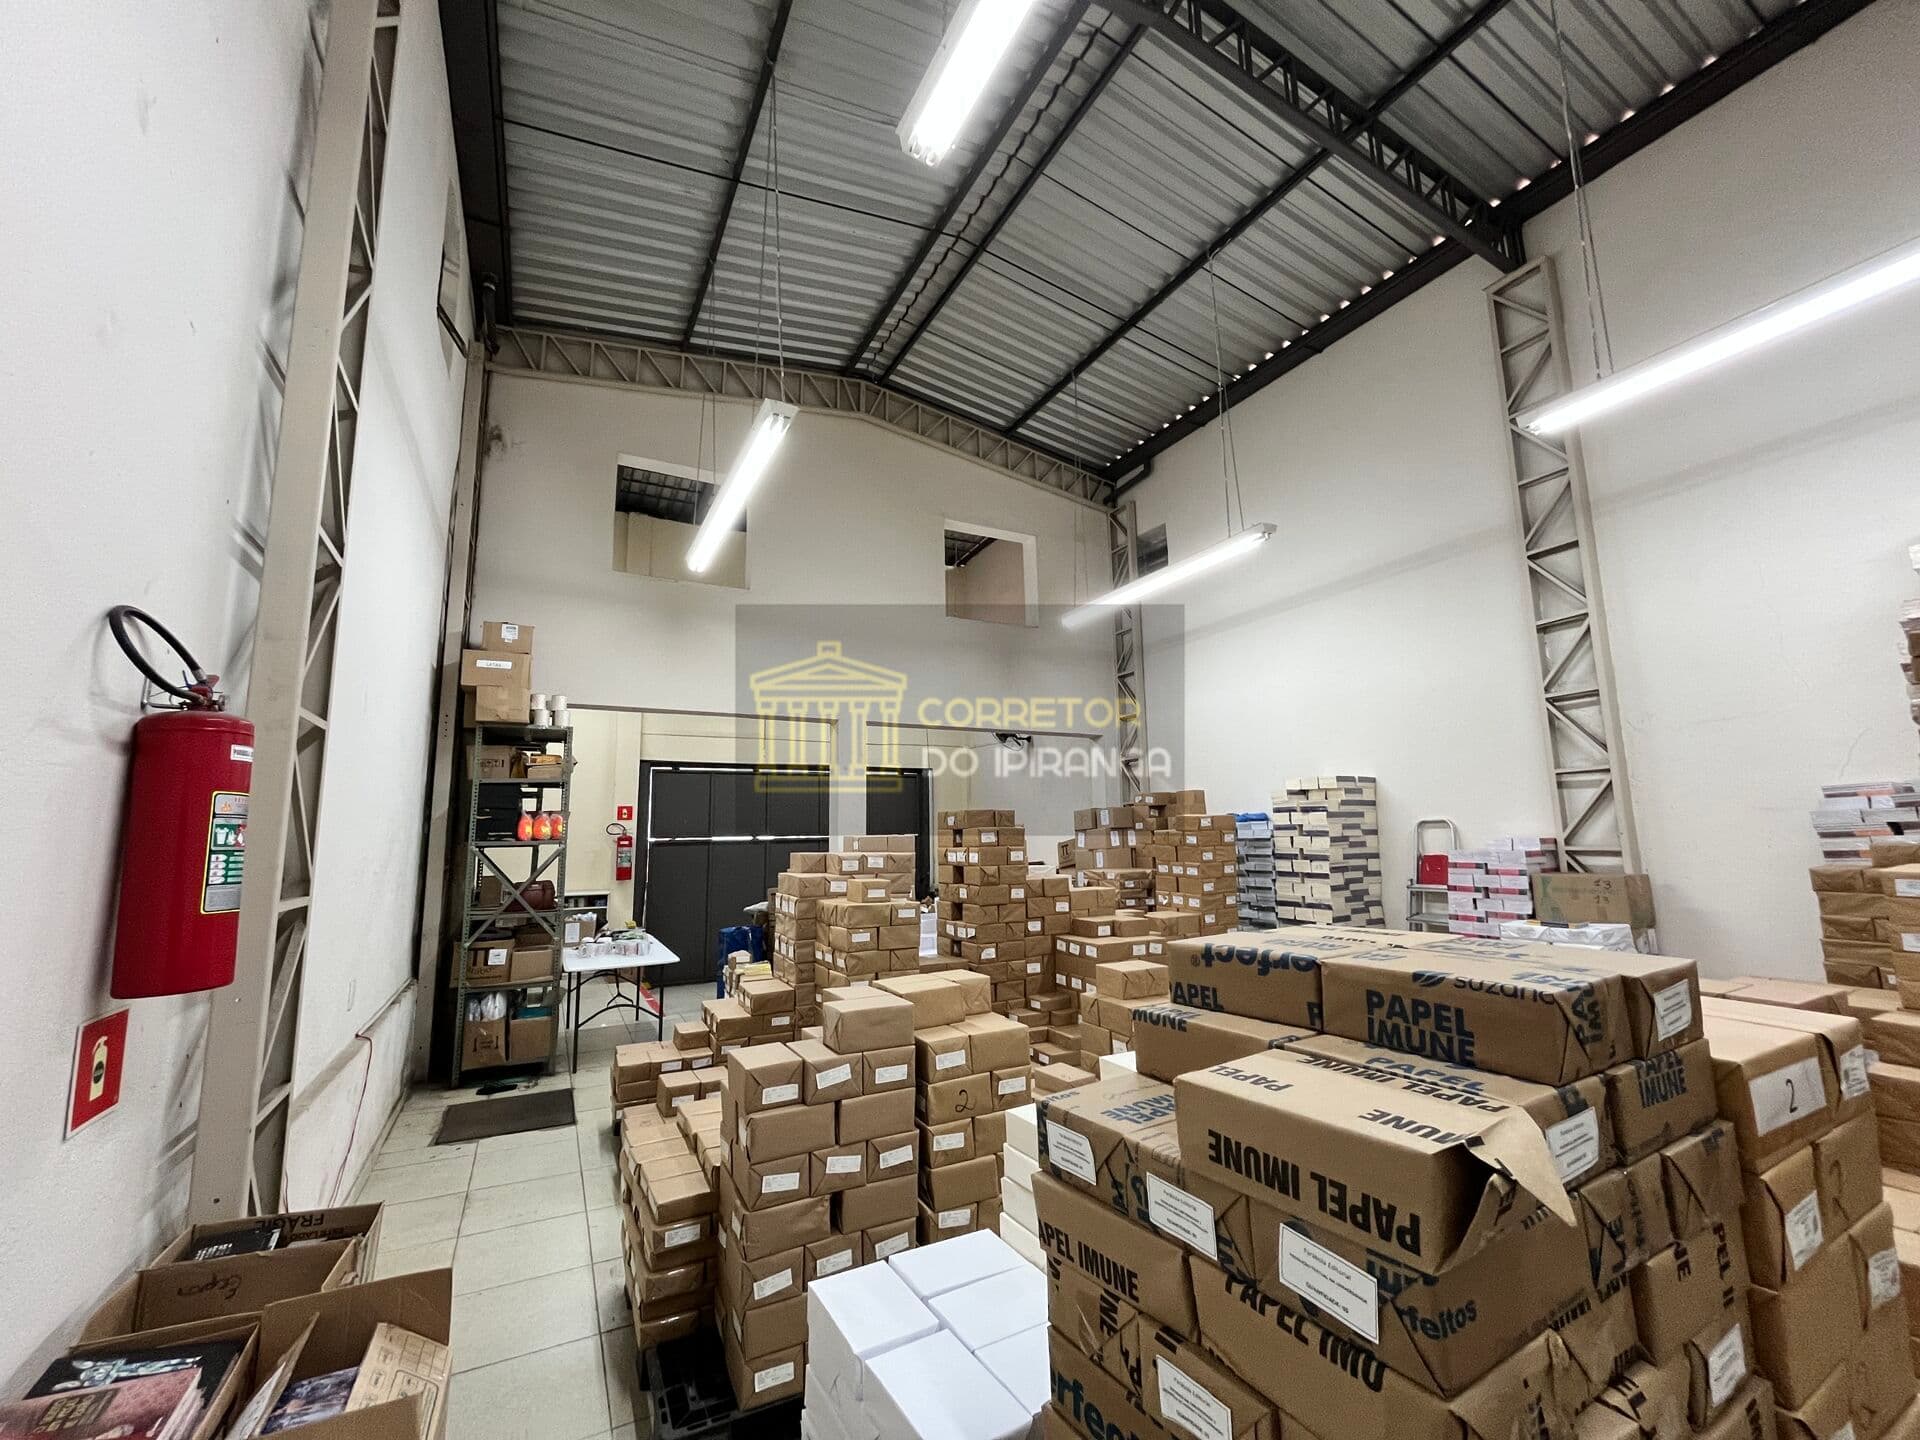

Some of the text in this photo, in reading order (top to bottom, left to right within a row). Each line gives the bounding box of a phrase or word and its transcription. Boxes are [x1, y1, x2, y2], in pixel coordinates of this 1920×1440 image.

[1201, 943, 1319, 976] erfect
[1169, 981, 1225, 1011] APEL
[1365, 988, 1475, 1038] PAPEL
[1132, 1008, 1188, 1033] MUNE
[1366, 1016, 1476, 1067] IMUNE
[1207, 1065, 1296, 1093] PAPEL
[1296, 1055, 1511, 1113] PAPEL IMUNE
[1364, 1056, 1486, 1092] PAPEL
[1639, 1067, 1688, 1109] IMUNE
[954, 1089, 976, 1113] 2
[1120, 1102, 1177, 1125] APEL
[1785, 1077, 1799, 1114] 2
[1207, 1128, 1422, 1257] PAPEL IMUNE
[1037, 1219, 1075, 1264] APEL
[1077, 1240, 1140, 1304] IMUNE
[1399, 1299, 1478, 1341] feitos
[1319, 1329, 1387, 1393] IMU
